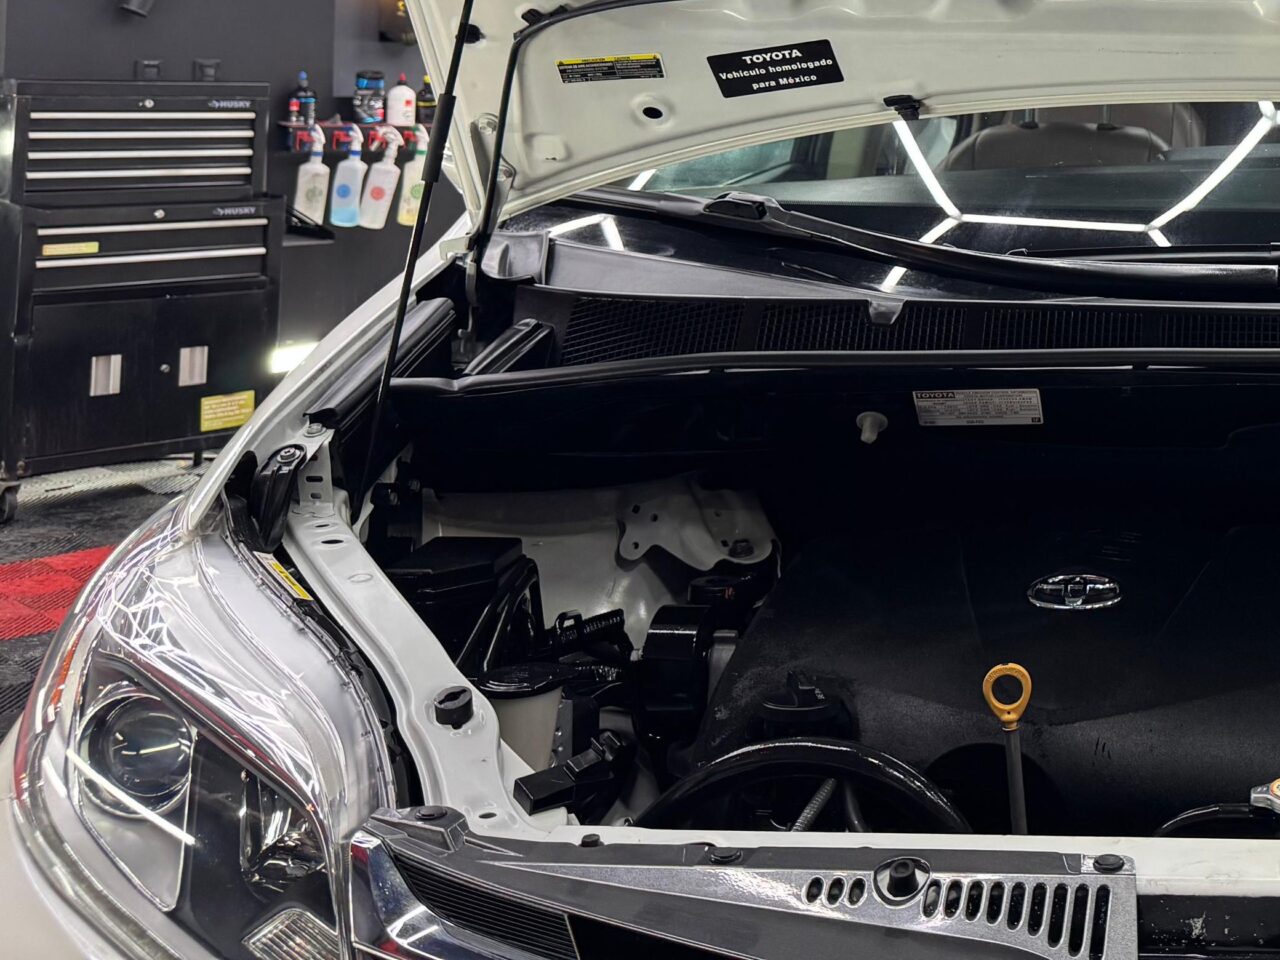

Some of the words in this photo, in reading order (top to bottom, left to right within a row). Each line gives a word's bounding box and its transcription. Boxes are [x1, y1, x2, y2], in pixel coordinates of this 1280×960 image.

[742, 49, 802, 64] TOYOTA
[769, 58, 833, 73] homologado
[752, 80, 776, 90] para
[779, 74, 817, 86] México
[219, 99, 251, 109] HUSKY
[224, 206, 256, 216] HUSKY
